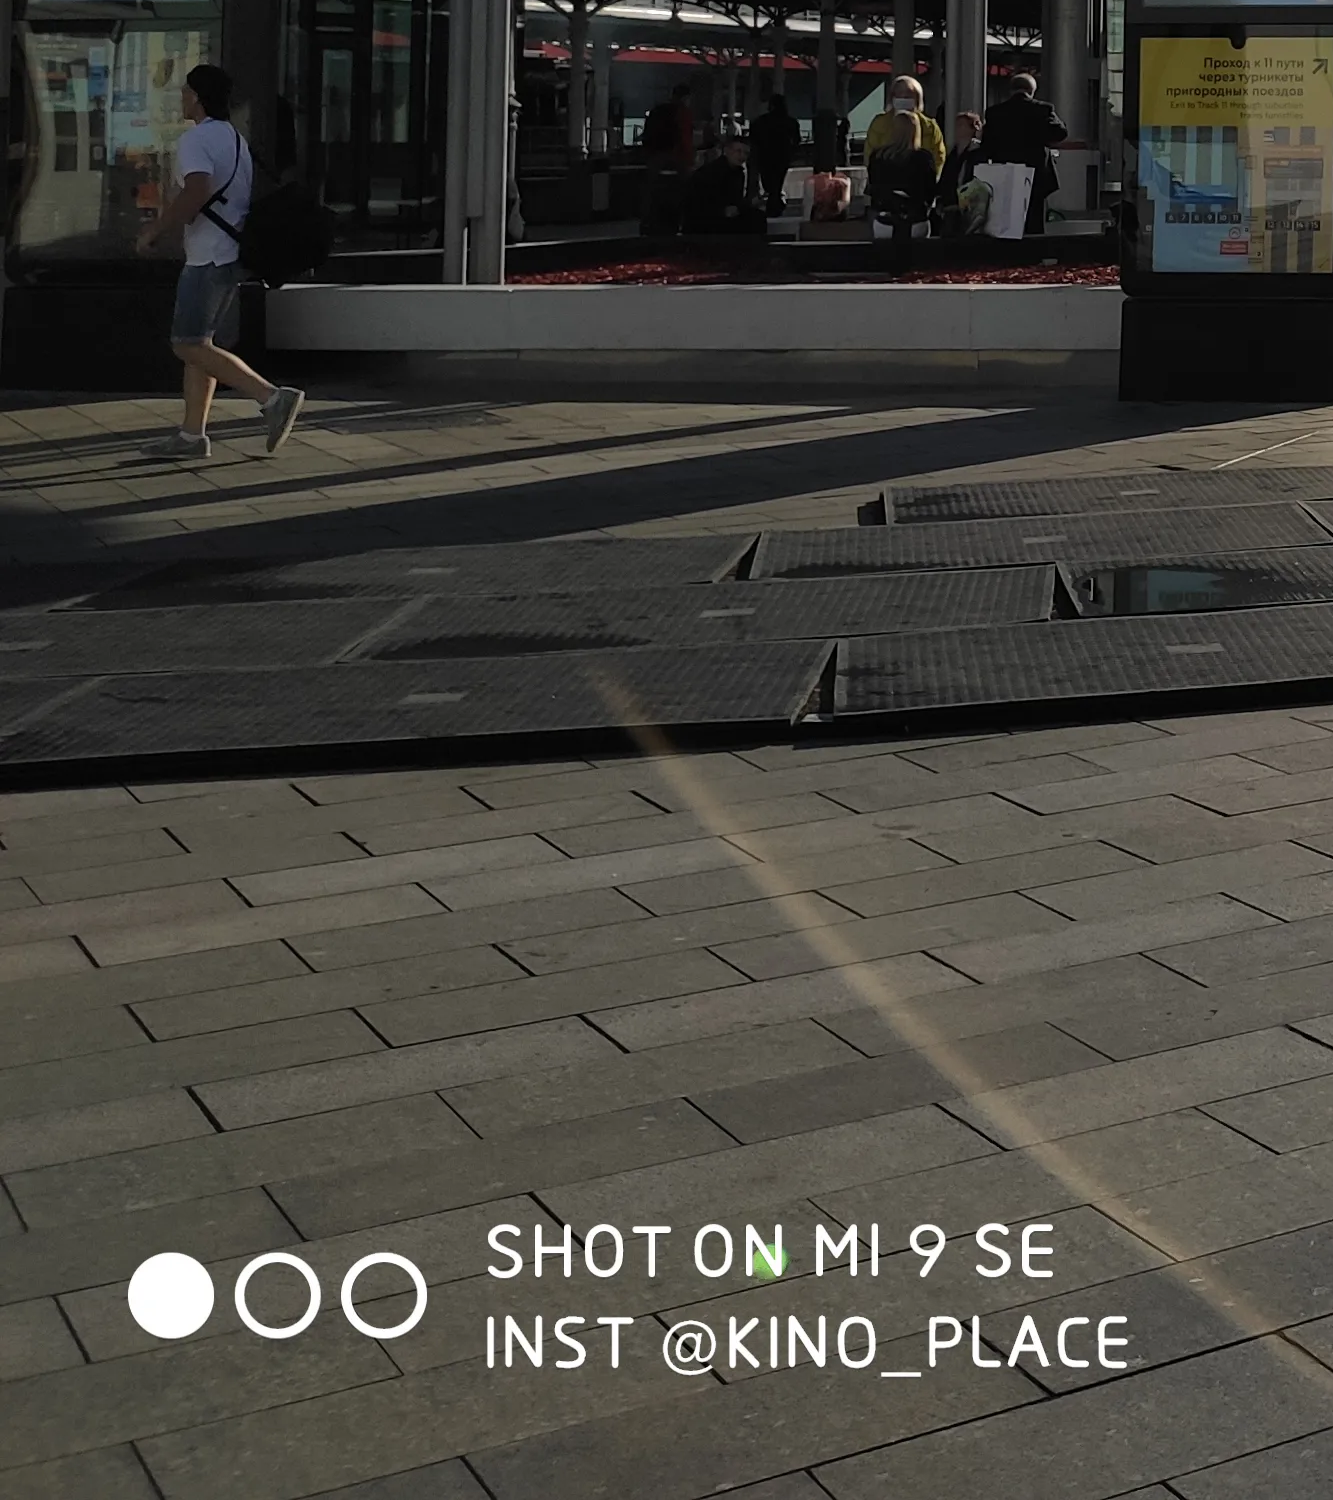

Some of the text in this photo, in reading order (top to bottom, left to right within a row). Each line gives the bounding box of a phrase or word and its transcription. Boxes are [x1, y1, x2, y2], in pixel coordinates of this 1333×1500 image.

[1203, 57, 1251, 72] Проход
[1264, 57, 1273, 68] 11
[1276, 59, 1304, 72] пути
[1199, 73, 1304, 84] через турникеты
[1166, 87, 1304, 98] пригородных поездов
